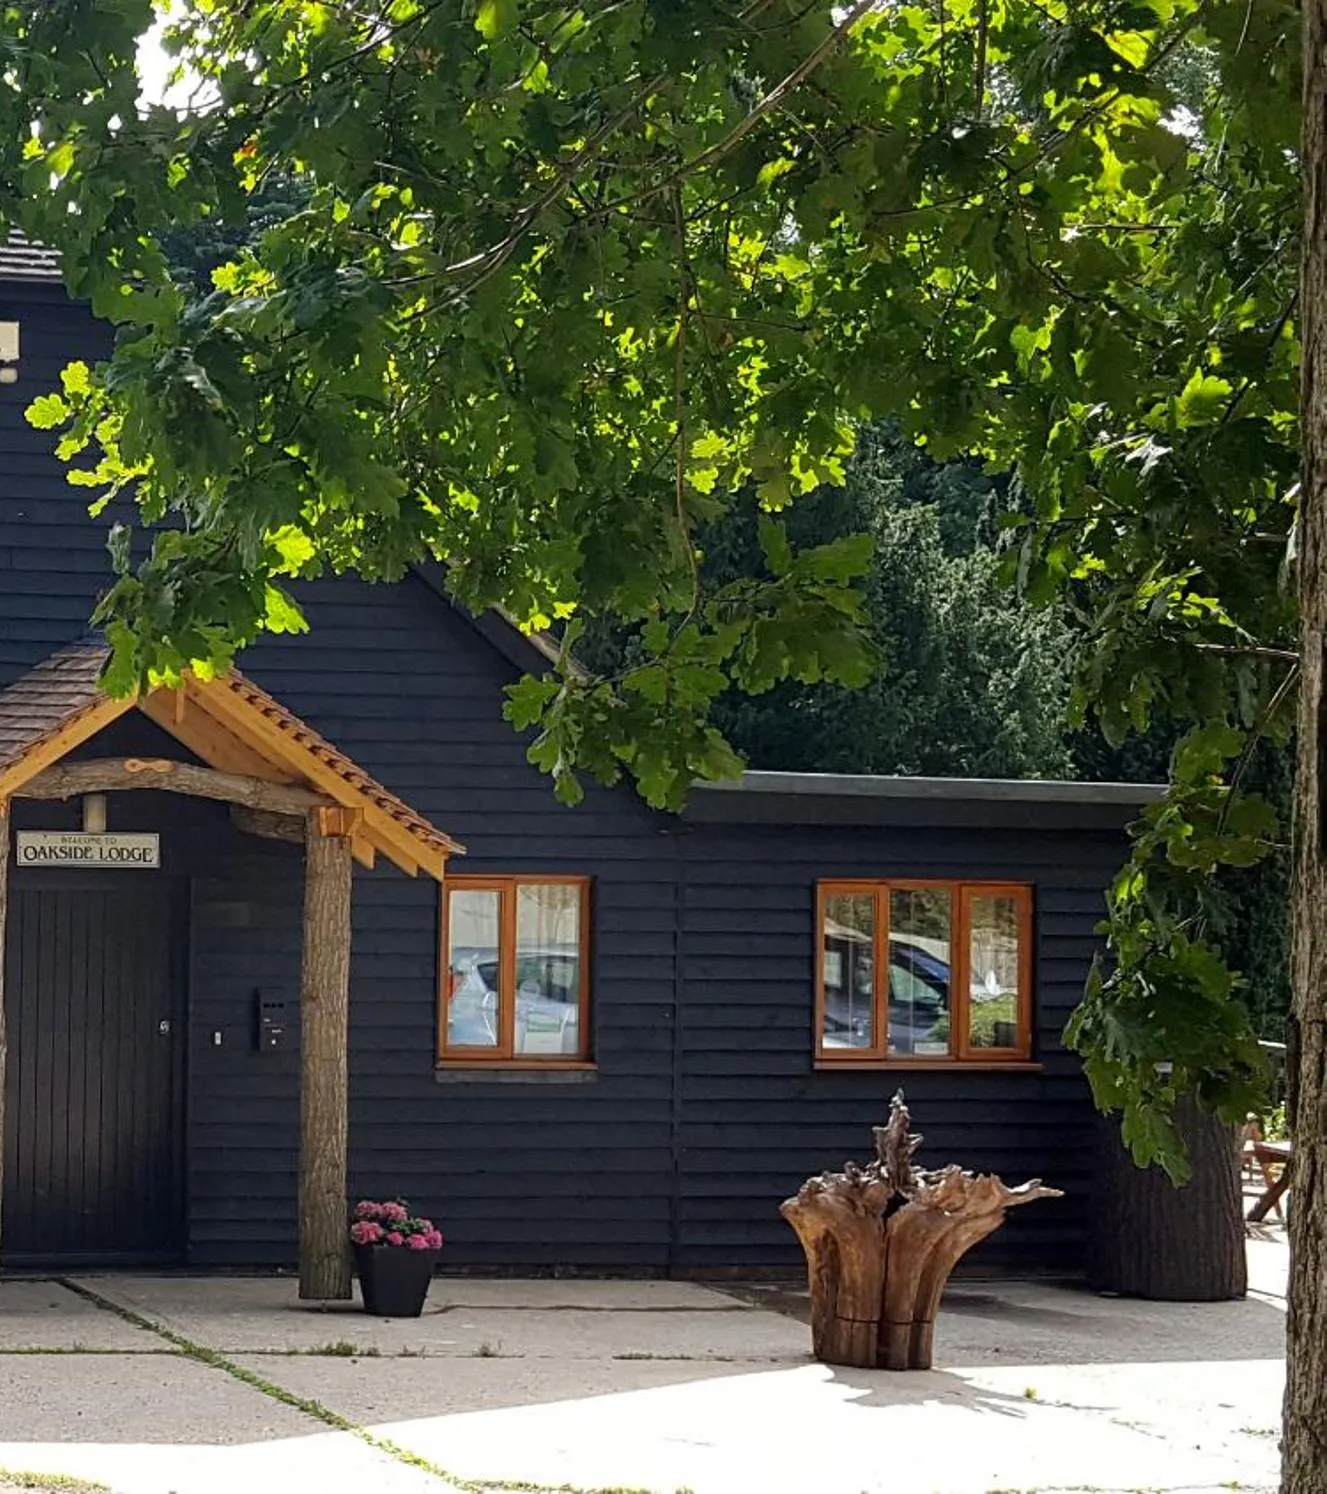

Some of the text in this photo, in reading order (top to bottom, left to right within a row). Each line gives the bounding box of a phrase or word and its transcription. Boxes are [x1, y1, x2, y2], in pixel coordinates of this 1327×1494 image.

[61, 836, 117, 845] WELCOME TO
[23, 845, 153, 863] OAKSIDE LODGE
